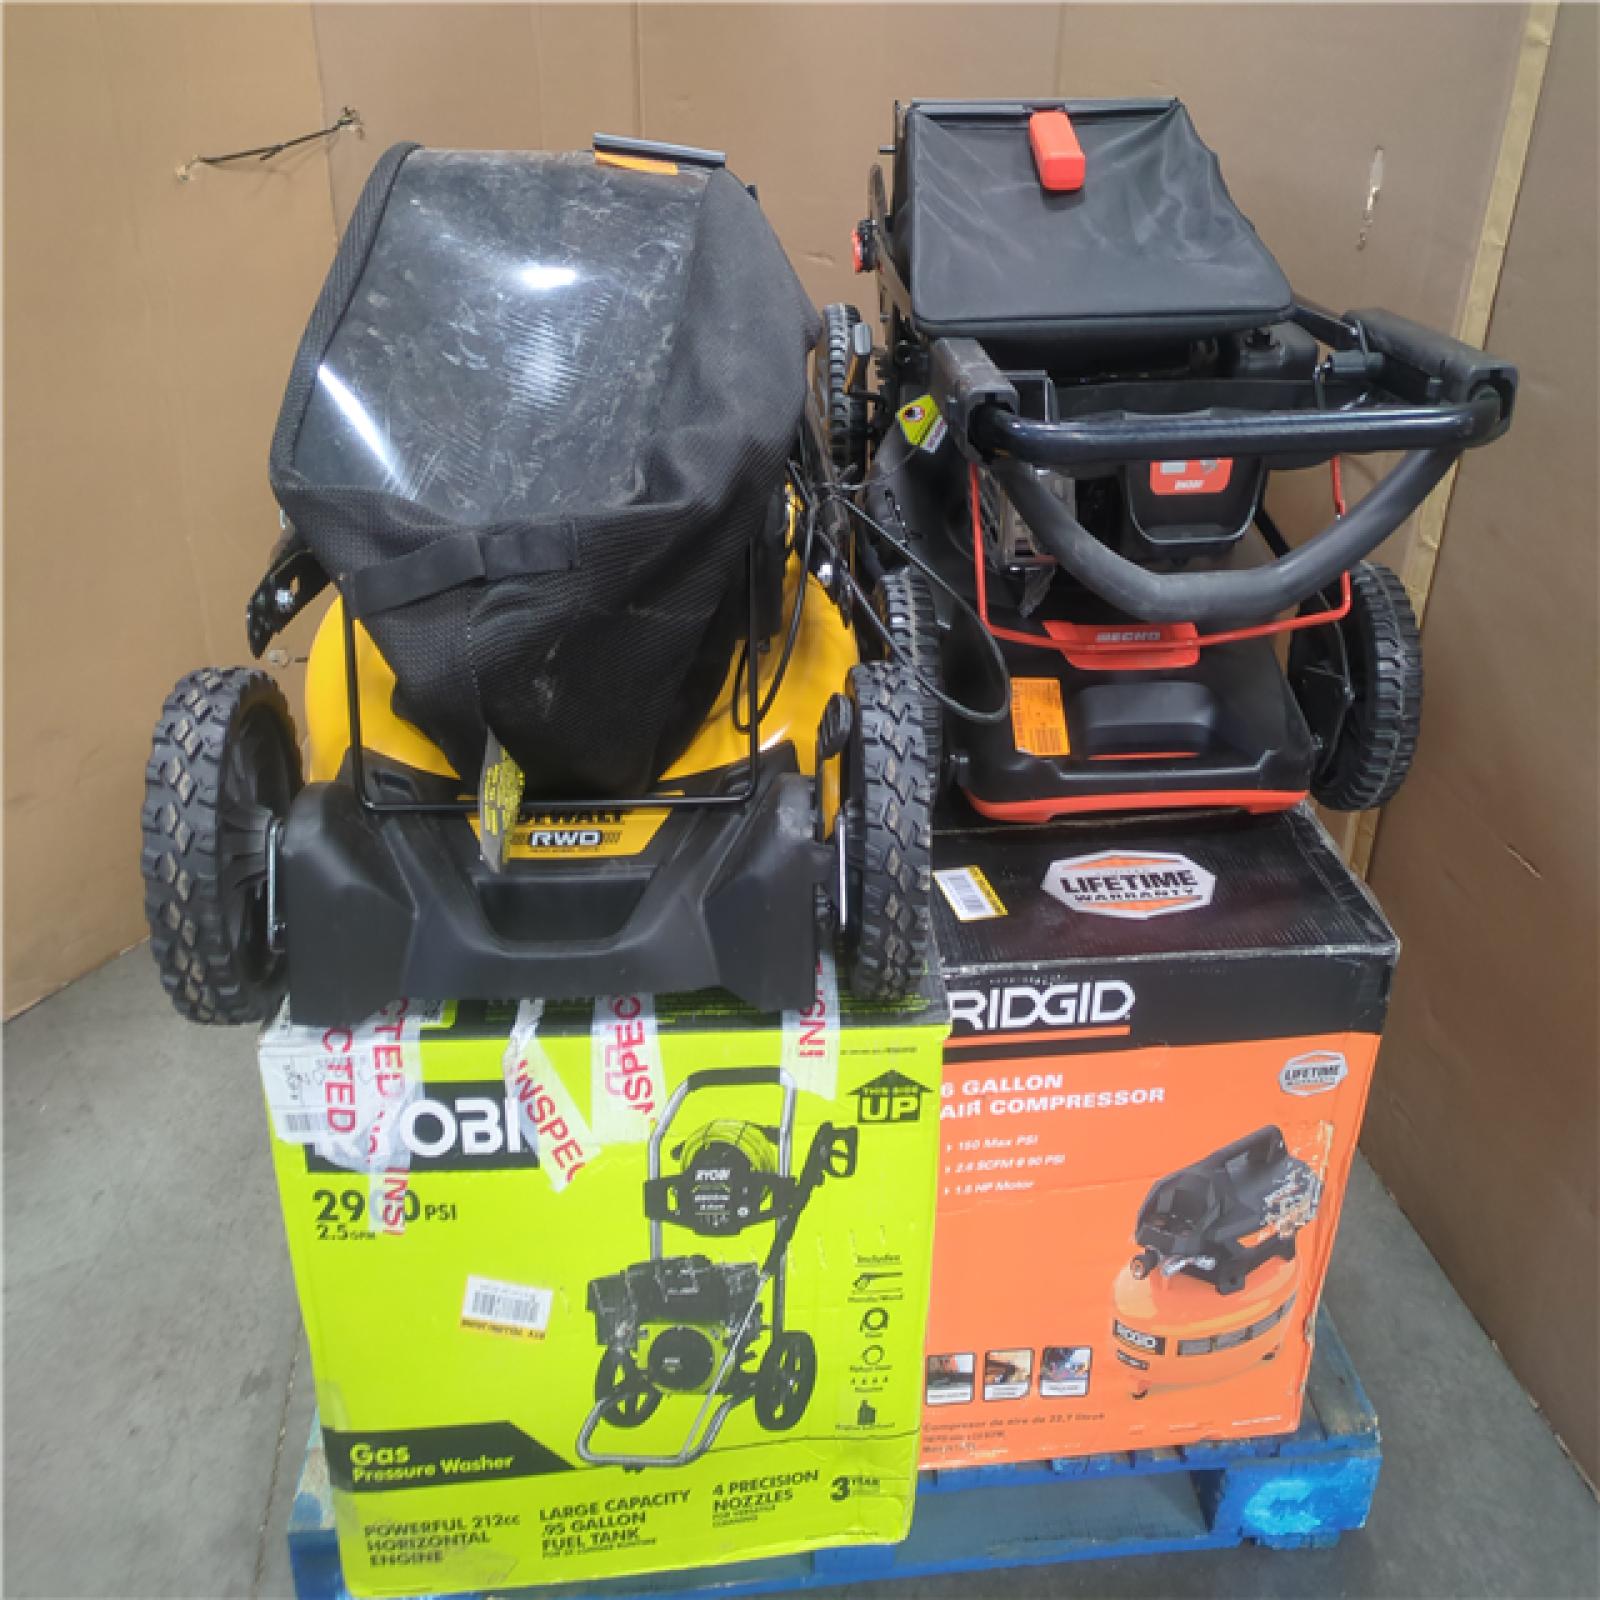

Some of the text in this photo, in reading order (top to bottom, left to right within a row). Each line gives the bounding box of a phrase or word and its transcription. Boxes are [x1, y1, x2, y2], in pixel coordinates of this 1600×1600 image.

[531, 832, 600, 846] RWD
[1060, 869, 1198, 894] LIFETIME
[1074, 887, 1194, 902] WARRANTY
[947, 979, 1136, 1031] RIDGID
[941, 1074, 1064, 1099] 6 GALLON
[861, 1096, 918, 1121] UP
[940, 1087, 1166, 1120] AIR COMPRESSOR
[399, 1098, 523, 1158] OBI
[1015, 1135, 1039, 1146] PSI
[1044, 1154, 1066, 1165] PSI
[424, 1205, 458, 1221] PSI
[317, 1224, 349, 1241] 2.5
[350, 1443, 409, 1466] Gas
[353, 1455, 514, 1482] Pressure Washer
[712, 1470, 820, 1496] 4 PRECISION
[830, 1475, 850, 1502] 3
[539, 1502, 600, 1522] LARGE
[604, 1489, 692, 1513] CAPACITY
[713, 1489, 794, 1513] NOZZLES
[365, 1517, 467, 1538] POWERFUL
[571, 1511, 647, 1533] GALLON
[590, 1527, 639, 1547] TANK
